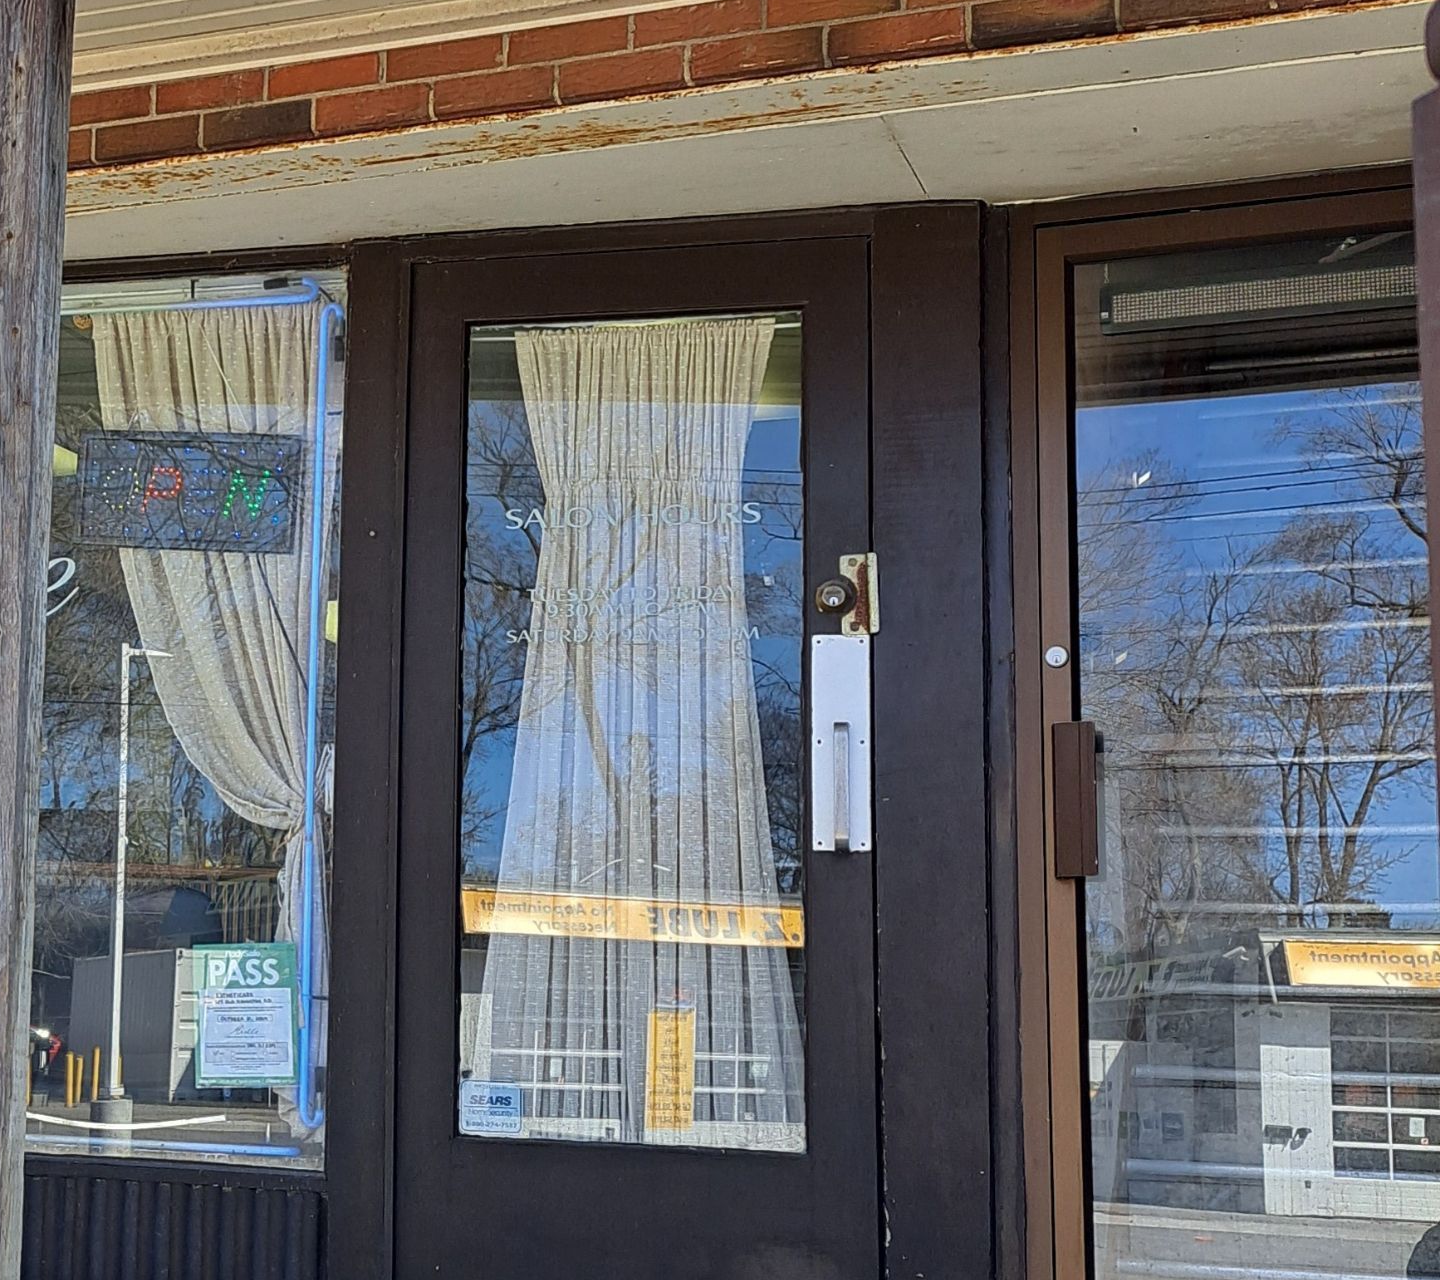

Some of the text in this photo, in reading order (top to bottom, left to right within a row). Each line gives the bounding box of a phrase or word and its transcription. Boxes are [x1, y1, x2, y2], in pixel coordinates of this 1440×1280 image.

[102, 467, 270, 518] OPEN
[505, 503, 761, 530] SALON HOURS
[527, 585, 736, 603] TUESDAY TO FRIDAY
[506, 627, 611, 644] SATURDAY
[209, 958, 280, 986] PASS
[470, 1094, 512, 1107] SEARS
